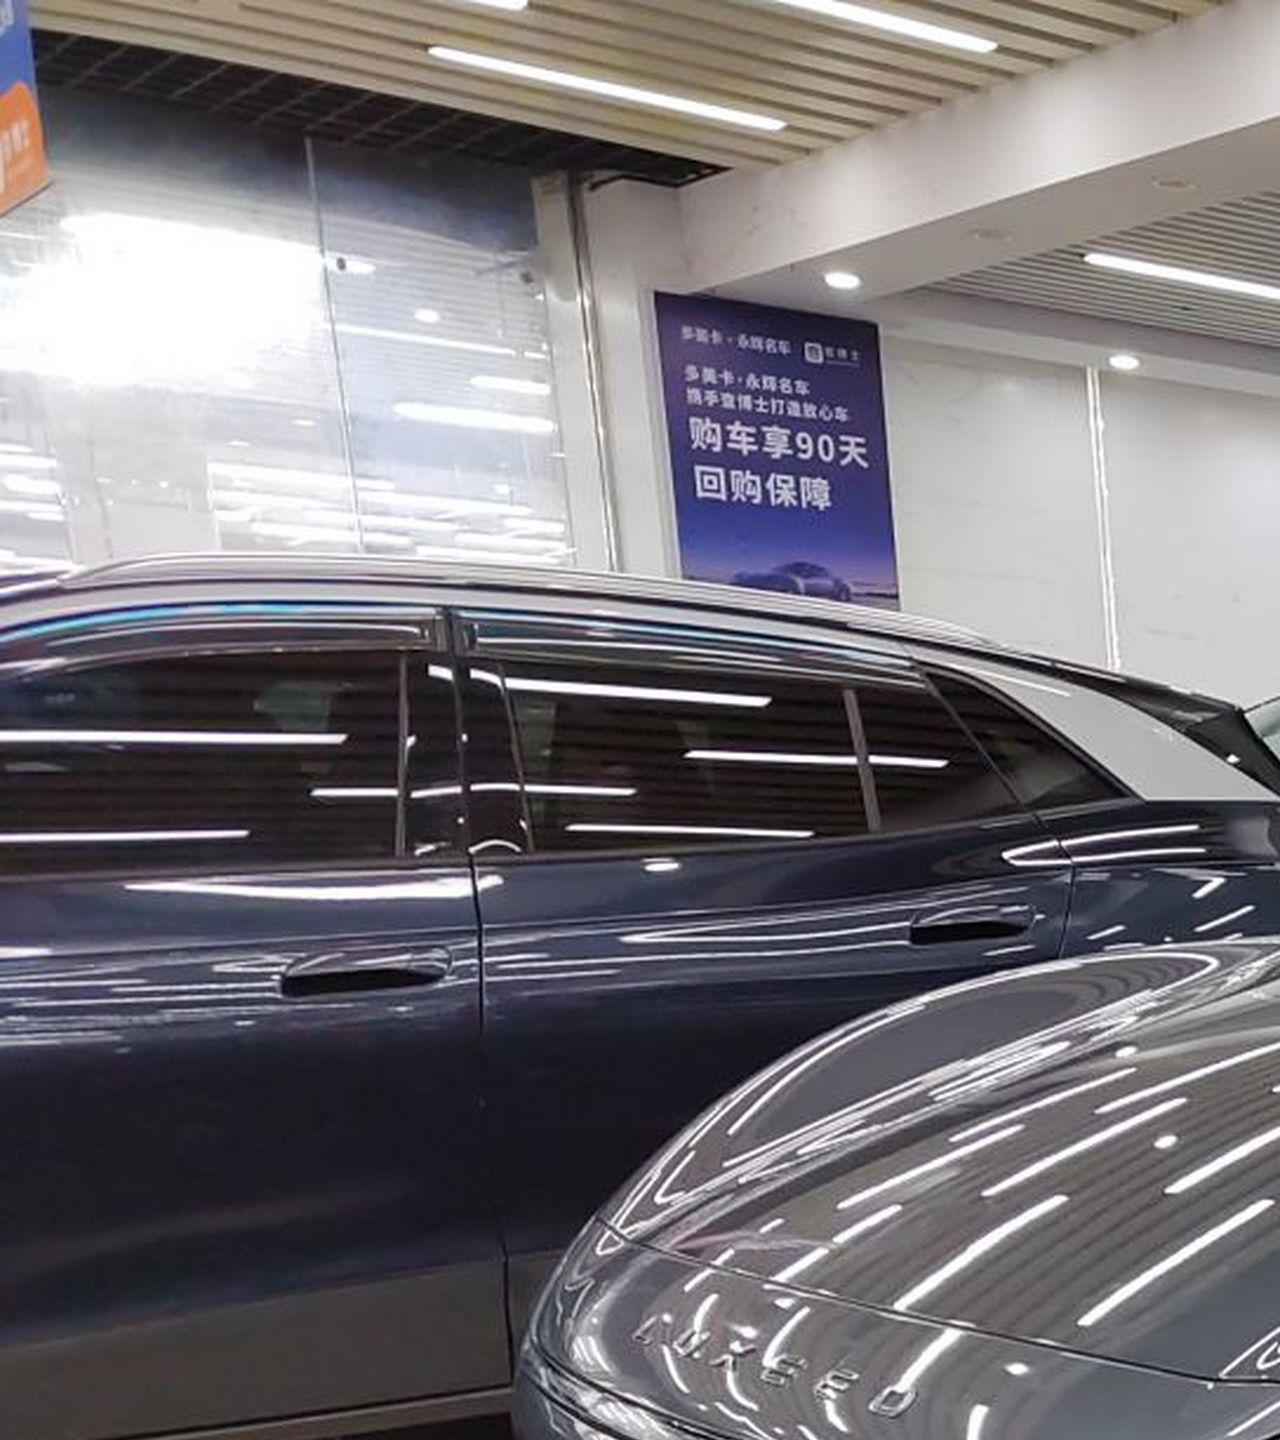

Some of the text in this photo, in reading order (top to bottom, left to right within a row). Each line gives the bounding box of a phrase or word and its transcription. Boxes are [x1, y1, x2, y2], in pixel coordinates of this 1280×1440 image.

[690, 417, 869, 468] 购车享90天
[694, 464, 832, 511] 回购保障
